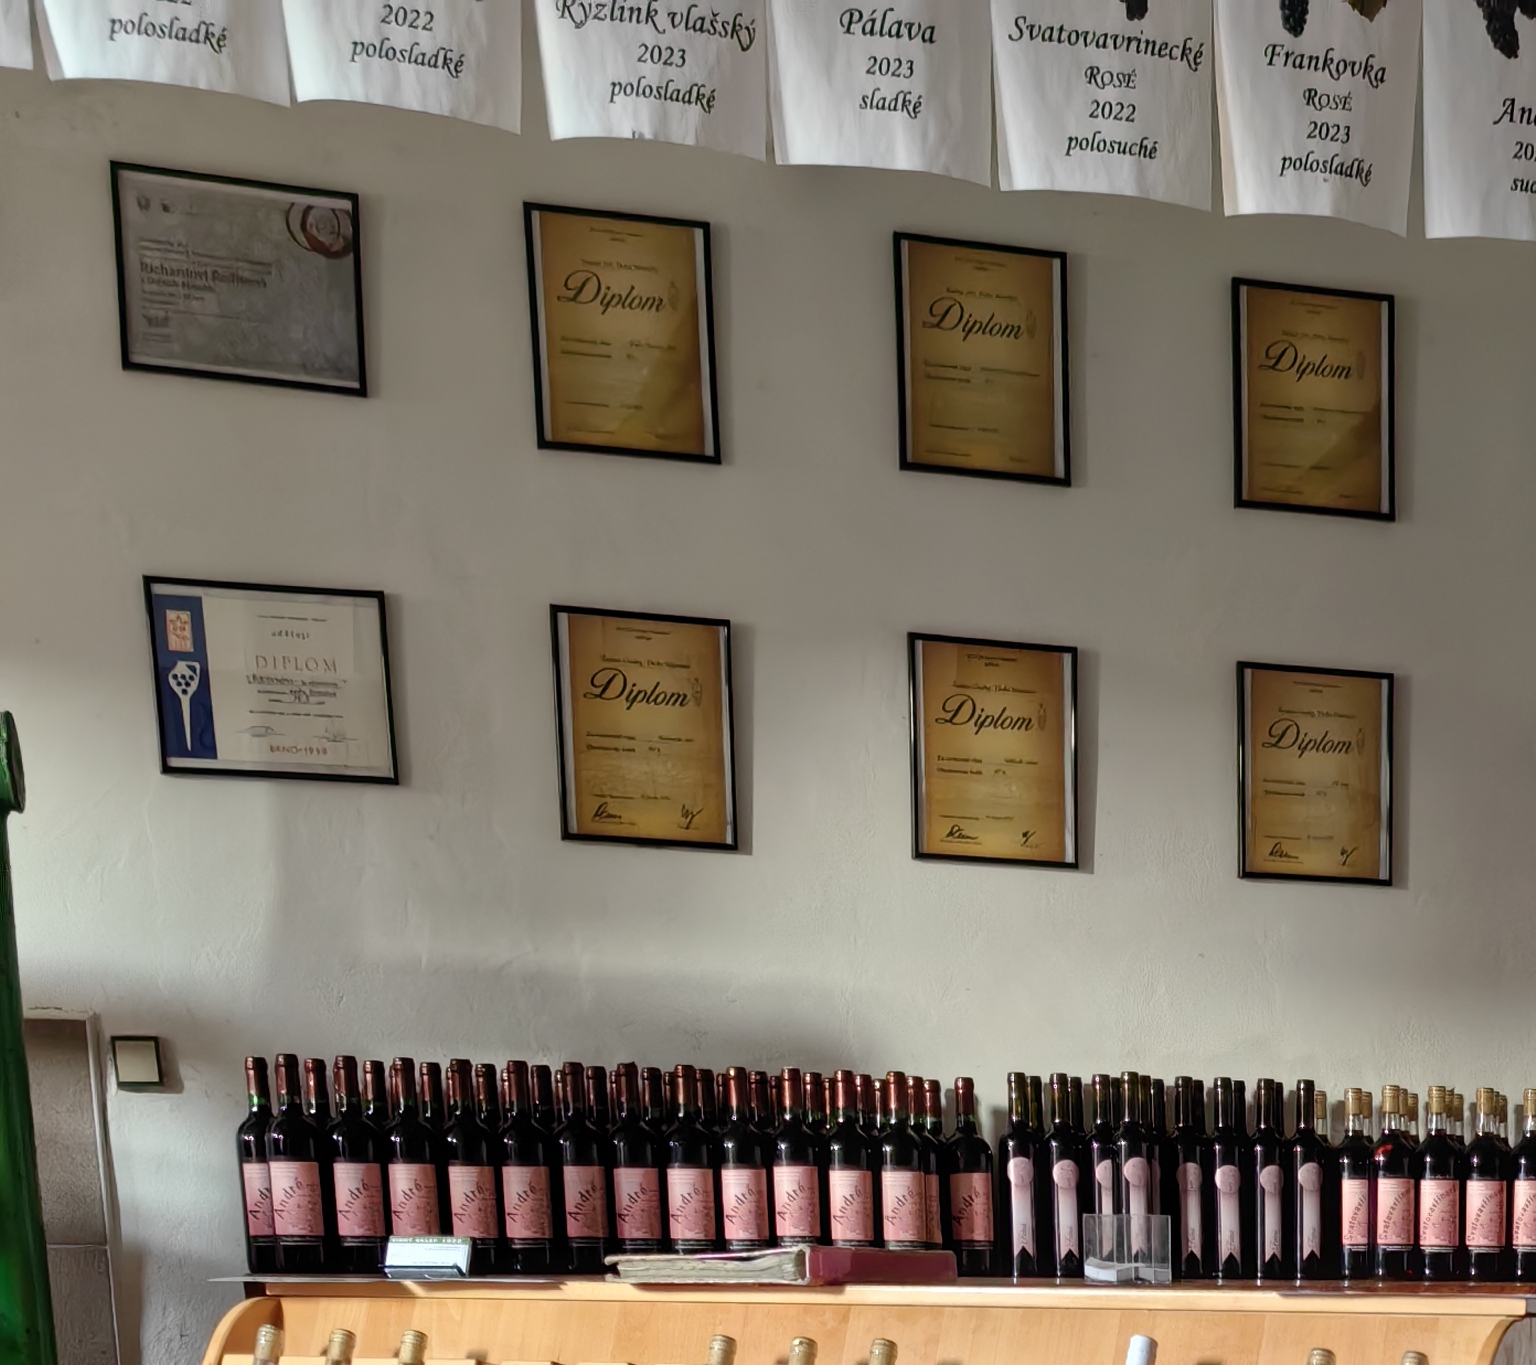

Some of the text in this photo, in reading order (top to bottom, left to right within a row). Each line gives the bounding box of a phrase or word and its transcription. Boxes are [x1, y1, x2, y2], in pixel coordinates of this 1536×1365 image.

[108, 13, 227, 54] polosladké
[380, 4, 435, 32] 2022
[556, 0, 756, 52] Ryzlink vlašský
[839, 7, 937, 44] Pálava
[350, 37, 465, 79] polosladké
[637, 43, 686, 68] 2023
[865, 56, 915, 79] 2023
[1263, 43, 1387, 90] Frankovka
[609, 76, 716, 114] polosladké
[859, 87, 923, 119] sladké
[1088, 99, 1136, 123] 2022
[1065, 131, 1159, 160] polosuché
[1306, 121, 1351, 145] 2023
[1279, 150, 1373, 187] polosladké
[557, 269, 666, 315] Diplom
[922, 296, 1024, 342] Diplom
[1258, 339, 1353, 382] Diplom
[255, 654, 337, 673] DIPLOM
[583, 667, 691, 710] Diplom
[935, 693, 1034, 735] Diplom
[1261, 717, 1352, 759] Diplom
